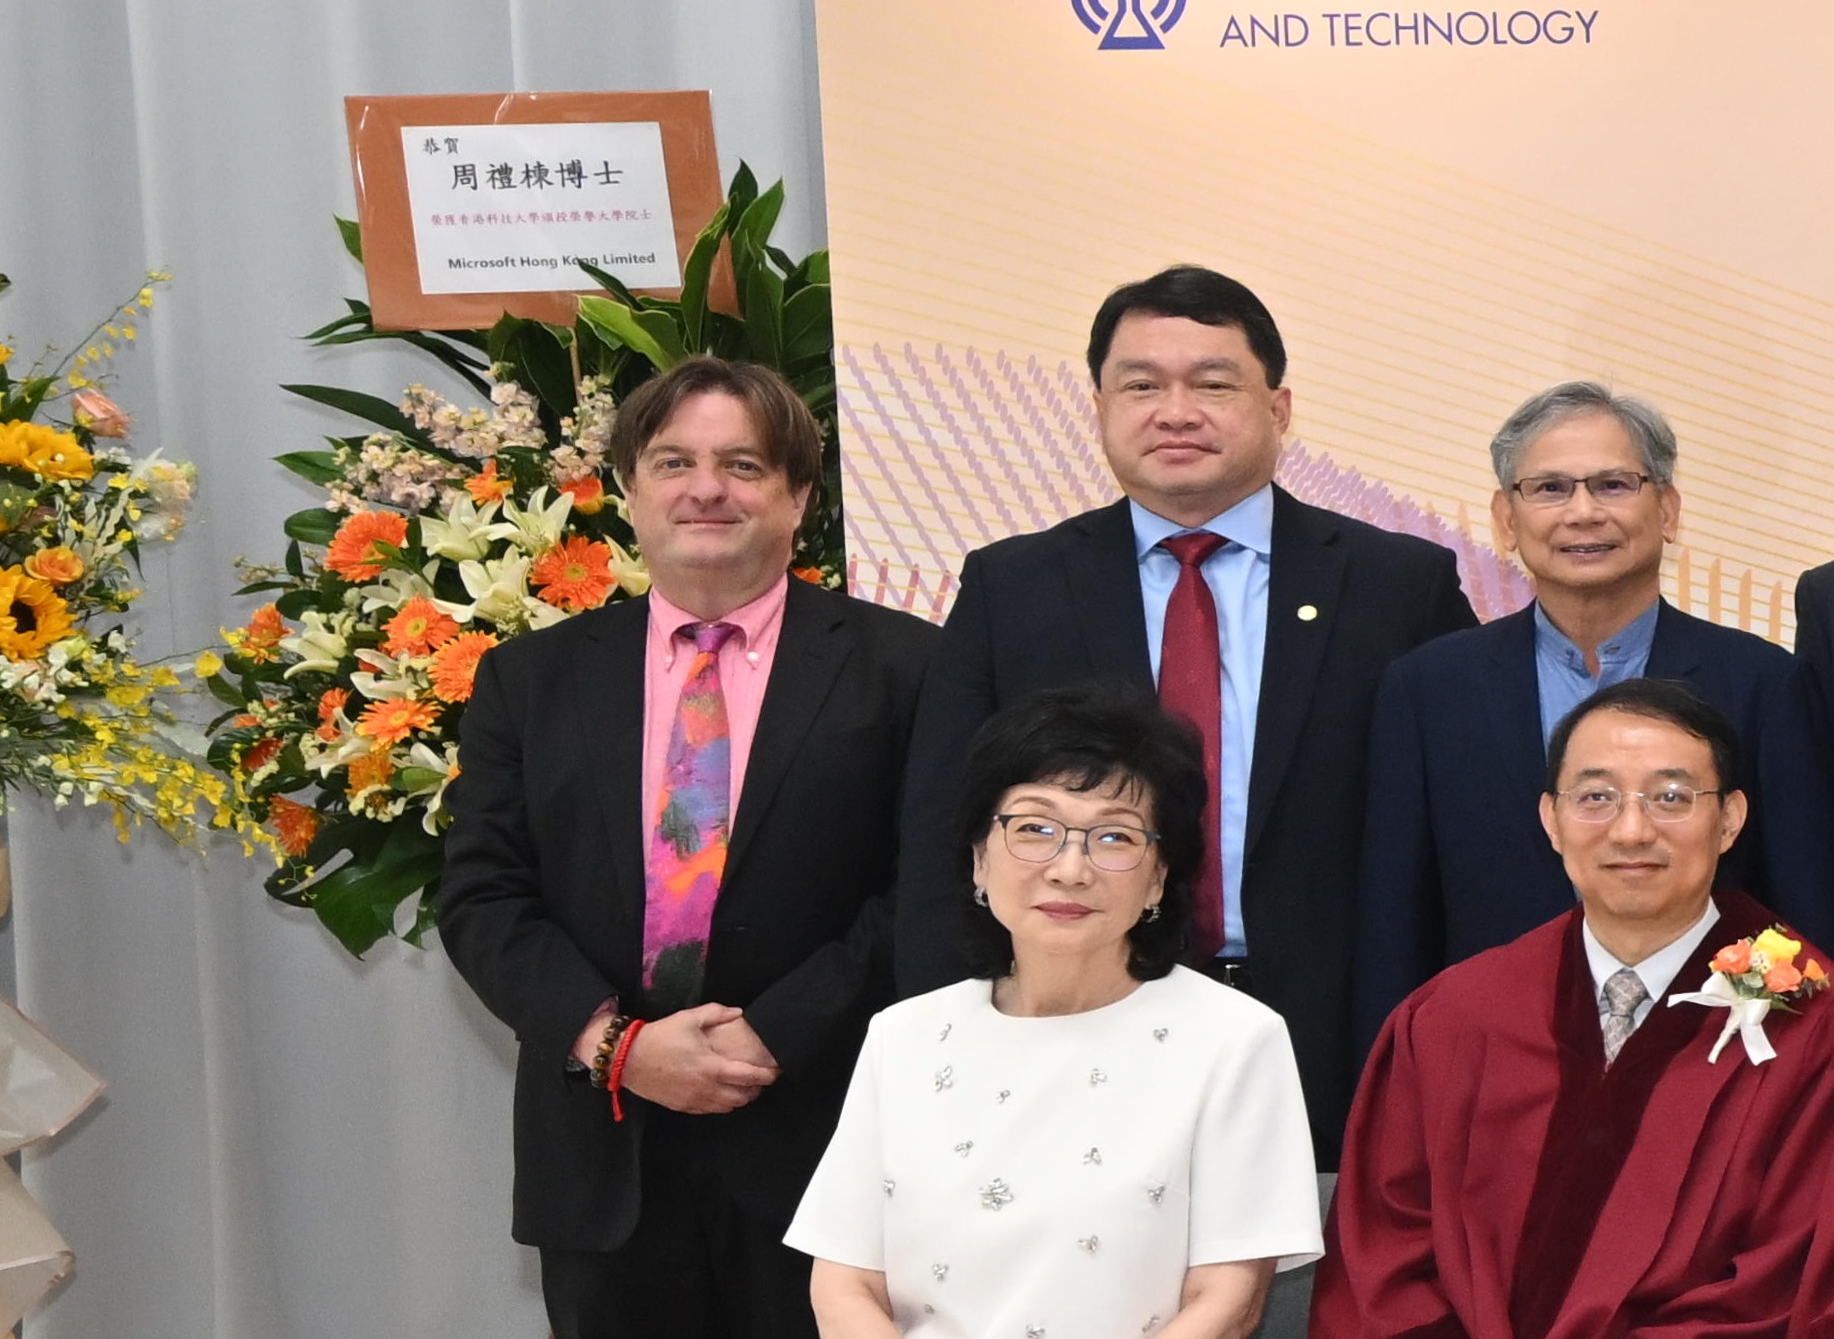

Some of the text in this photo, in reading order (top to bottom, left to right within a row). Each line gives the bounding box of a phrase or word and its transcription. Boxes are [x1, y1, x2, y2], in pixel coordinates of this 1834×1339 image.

[1219, 10, 1600, 49] AND TECHNOLOGY
[448, 256, 516, 270] Microsoft
[520, 255, 558, 270] Hong
[603, 252, 656, 265] Limited
